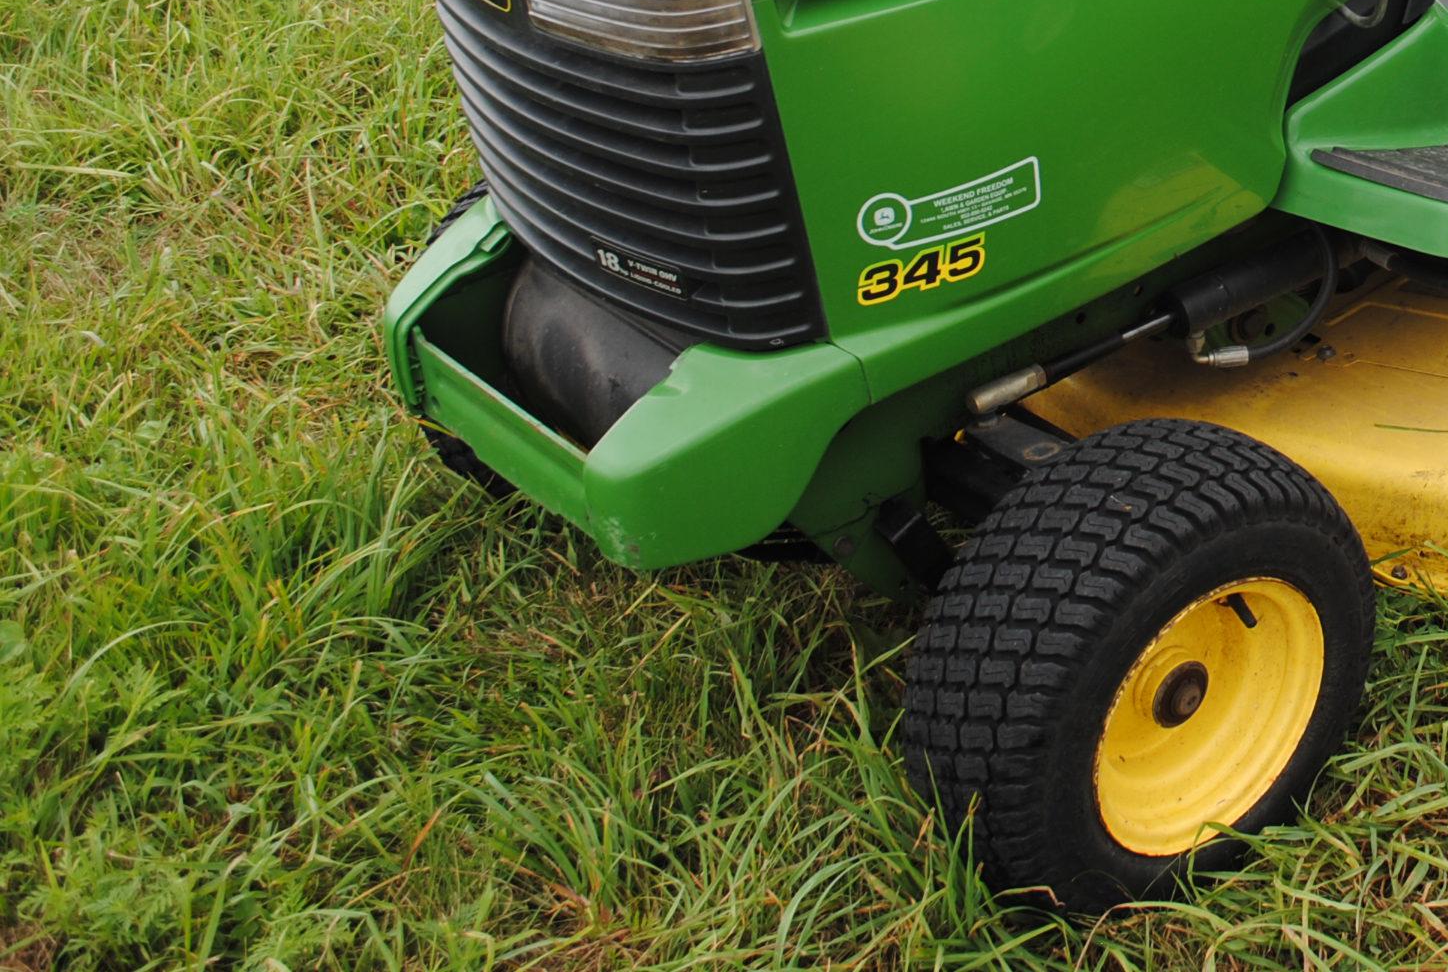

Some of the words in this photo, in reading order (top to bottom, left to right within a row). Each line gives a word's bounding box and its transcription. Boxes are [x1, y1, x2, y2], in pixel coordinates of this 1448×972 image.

[933, 190, 975, 207] WEEKEND
[976, 177, 1014, 196] FREEDOM
[597, 249, 620, 272] 18
[858, 232, 985, 305] 345
